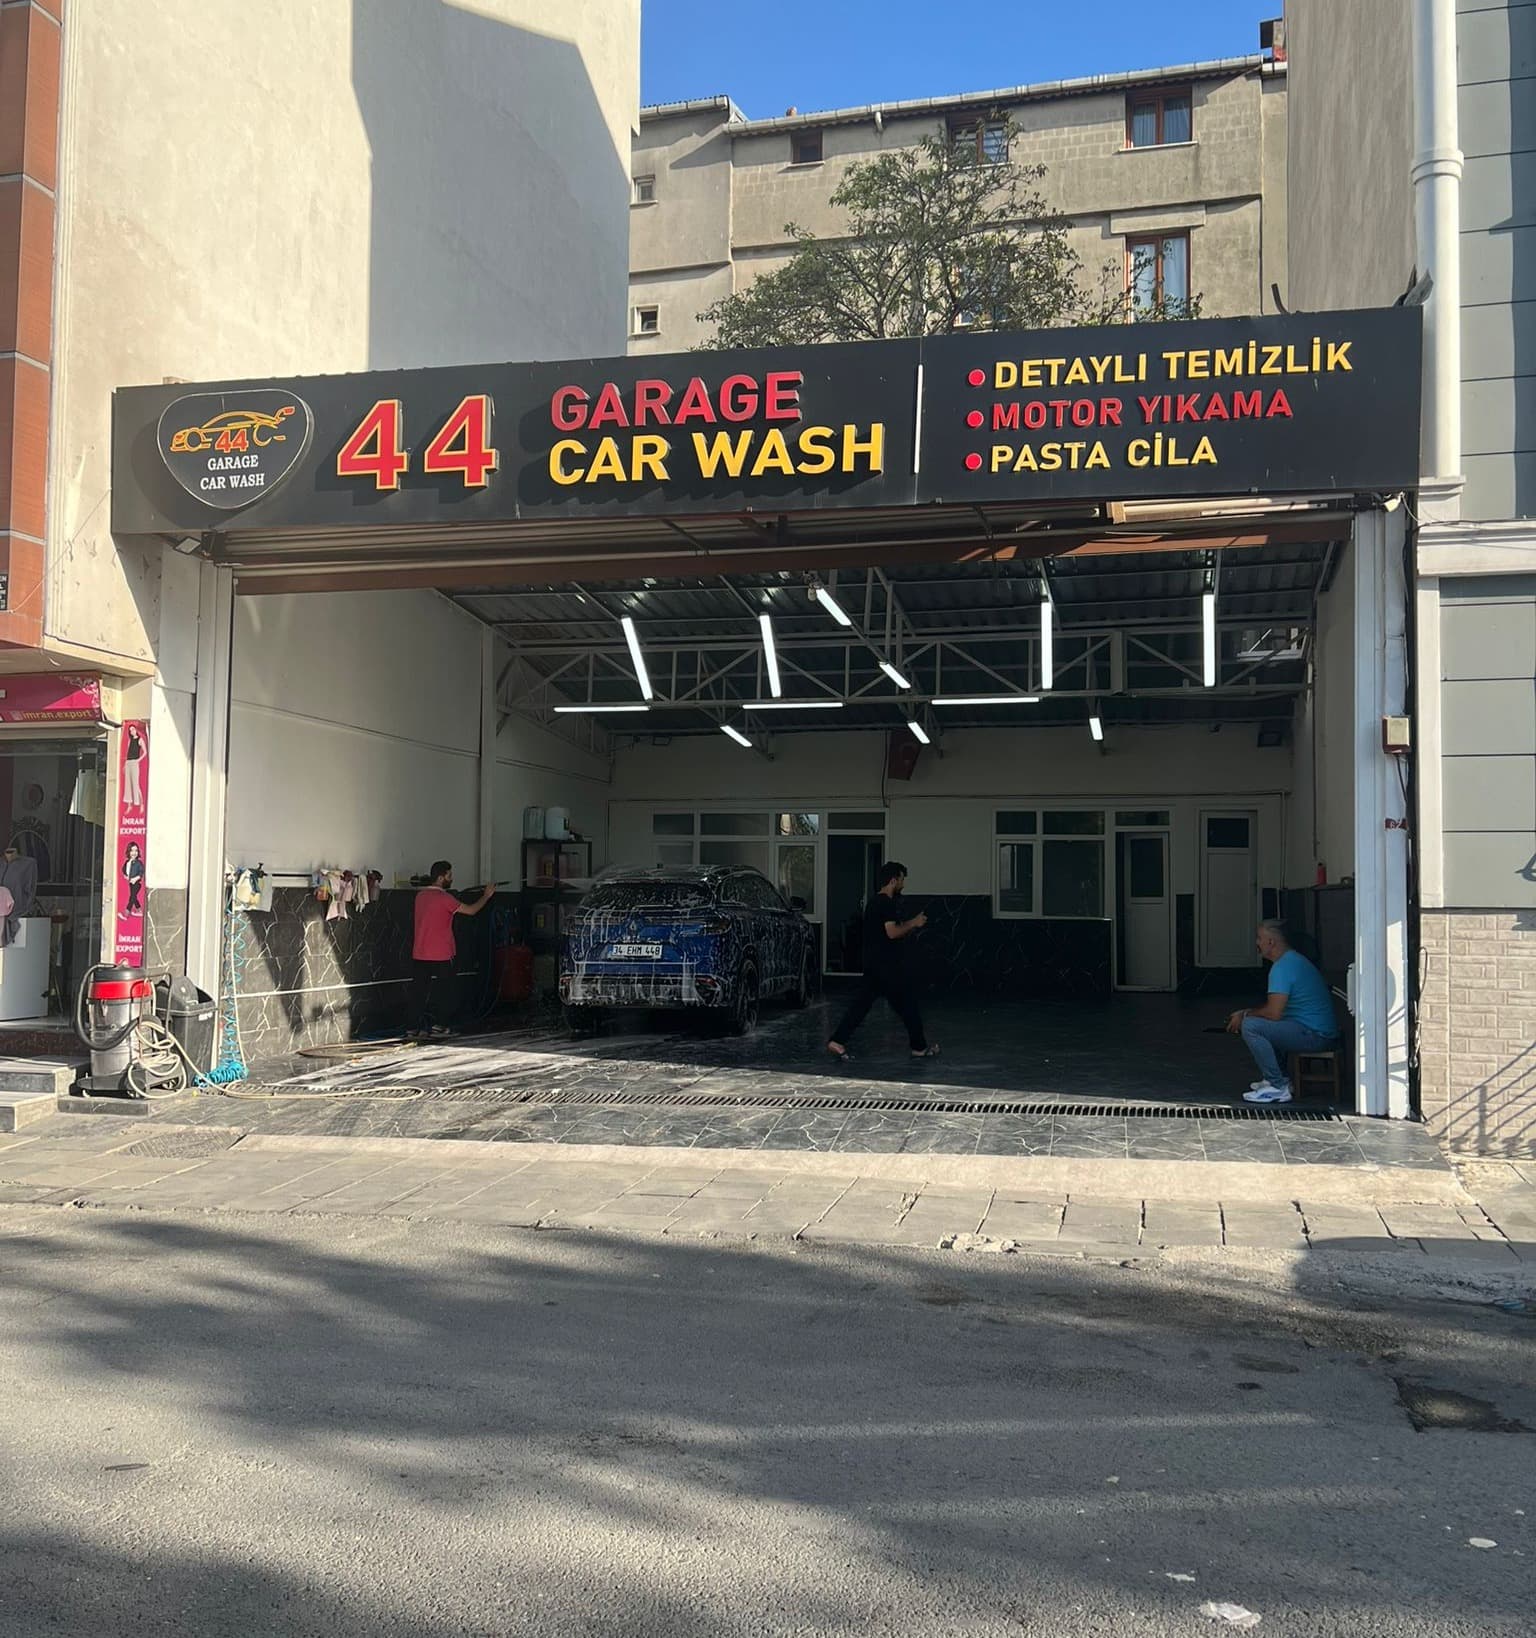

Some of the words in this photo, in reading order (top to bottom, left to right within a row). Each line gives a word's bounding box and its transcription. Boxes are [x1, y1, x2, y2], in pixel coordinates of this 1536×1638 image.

[994, 353, 1148, 389] DETAYLI
[1162, 336, 1354, 380] TEMİZLİK
[551, 371, 804, 431] GARAGE
[992, 397, 1123, 431] MOTOR
[1138, 388, 1294, 424] YIKAMA
[215, 428, 249, 453] 44
[337, 394, 499, 490] 44
[990, 441, 1111, 473] PASTA
[1127, 431, 1218, 467] CİLA
[207, 454, 259, 471] GARAGE
[549, 434, 671, 485] CAR
[691, 423, 885, 478] WASH
[200, 477, 226, 490] CAR
[229, 473, 265, 488] WASH
[22, 710, 92, 720] imran.export
[120, 827, 146, 835] EXPORT
[115, 945, 143, 953] EXPORT
[613, 946, 623, 954] 34
